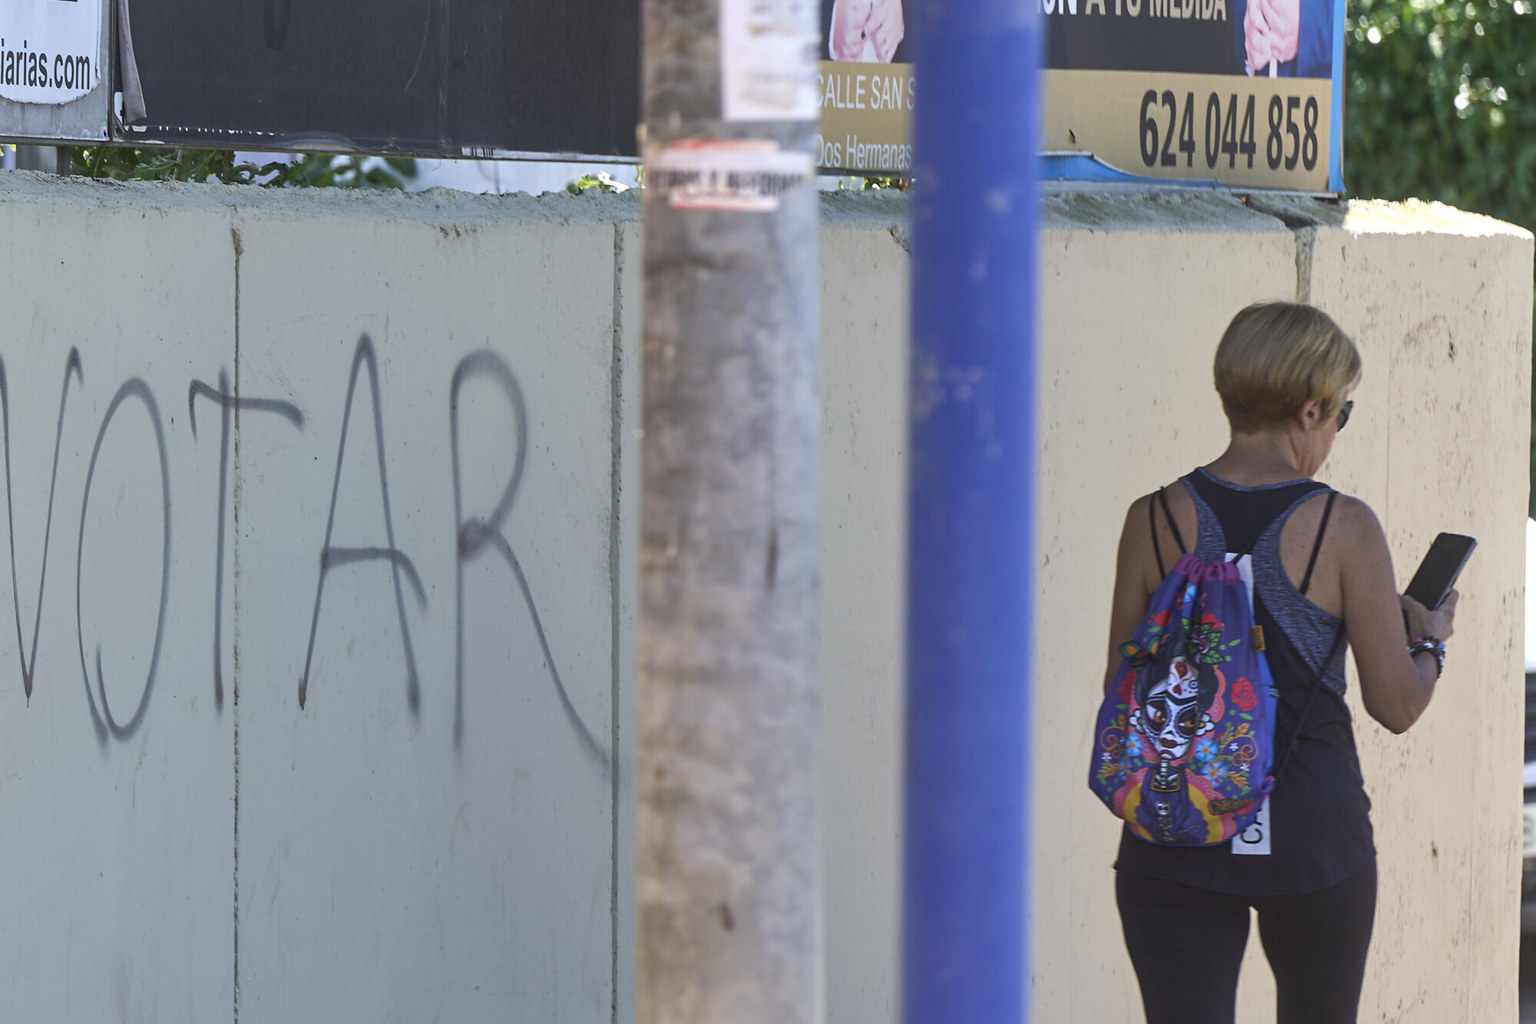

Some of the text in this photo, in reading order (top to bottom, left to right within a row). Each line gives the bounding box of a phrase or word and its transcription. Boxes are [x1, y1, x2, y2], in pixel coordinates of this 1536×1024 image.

[870, 75, 903, 110] SAN
[1139, 90, 1319, 171] 624 044 858
[846, 135, 912, 169] Hermanas
